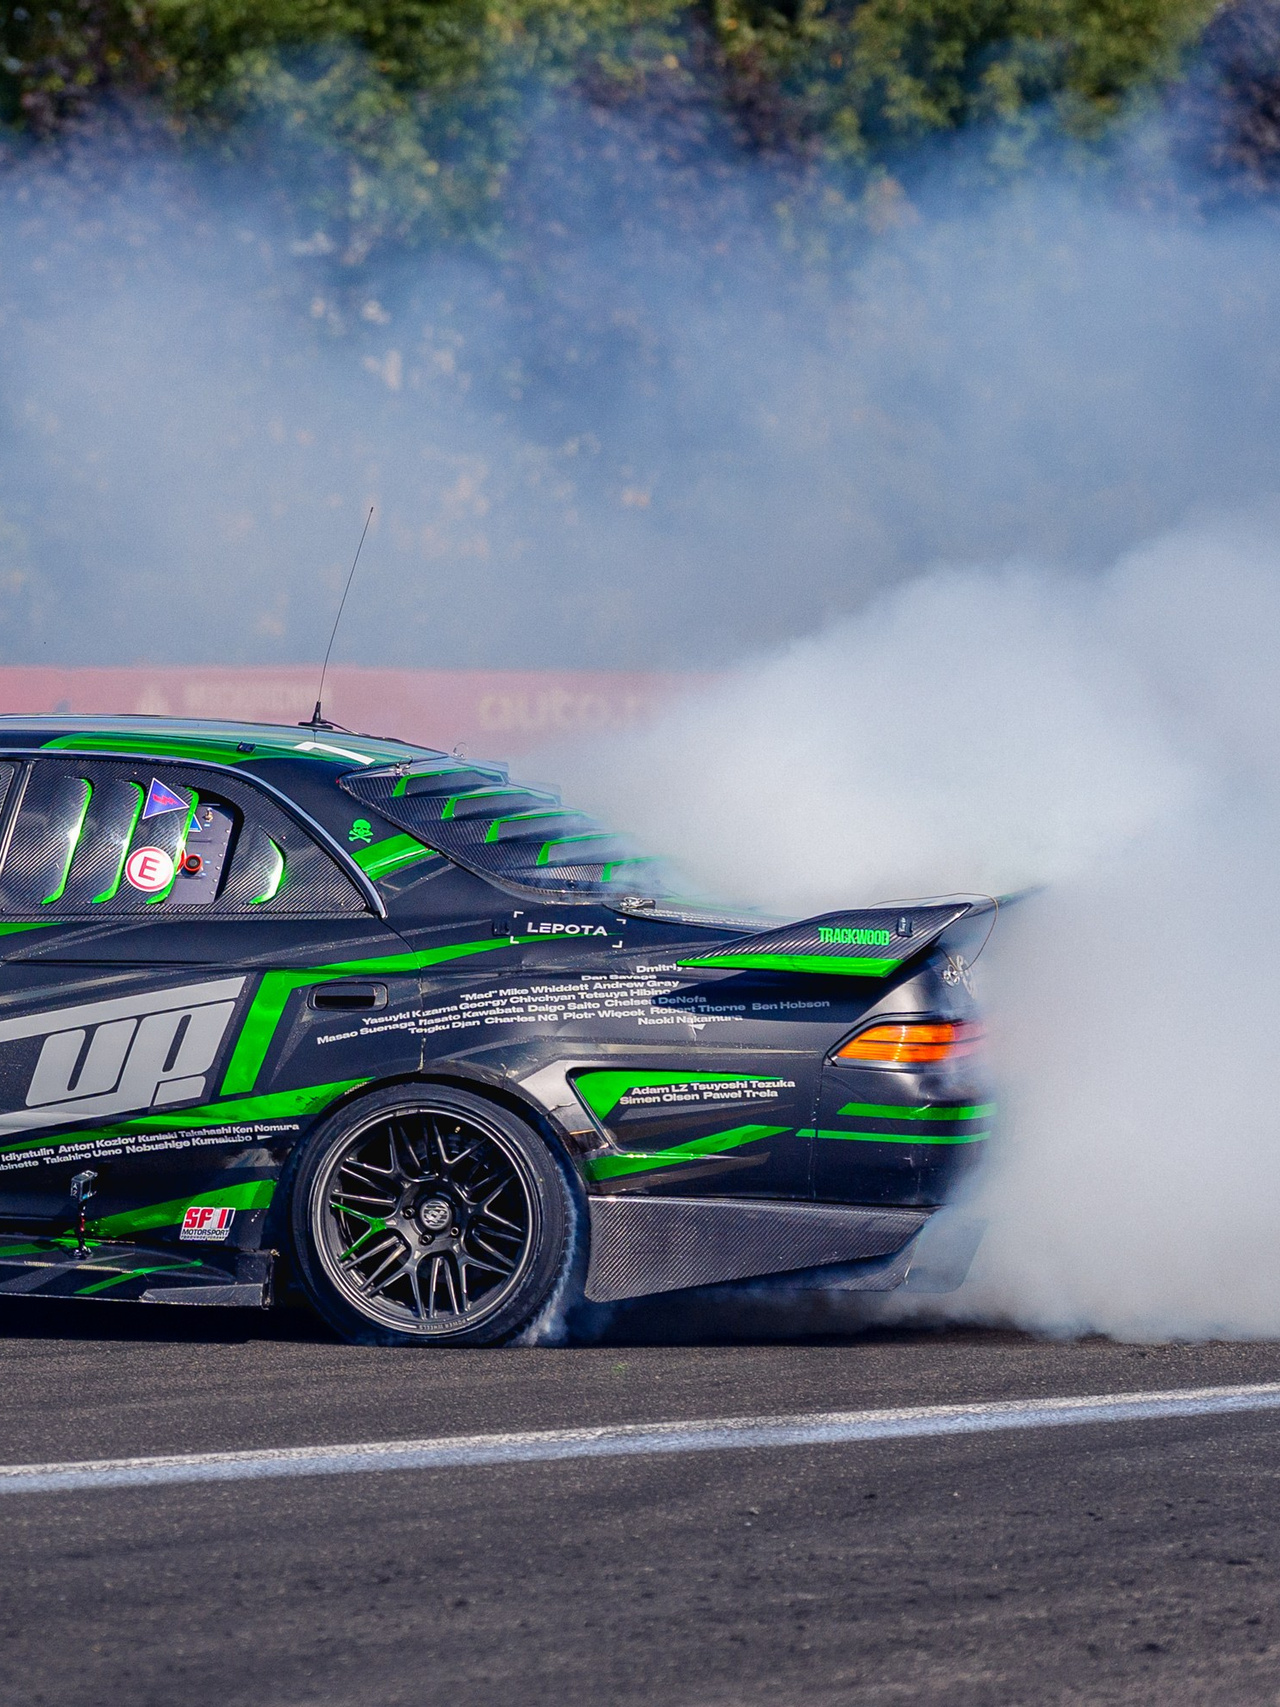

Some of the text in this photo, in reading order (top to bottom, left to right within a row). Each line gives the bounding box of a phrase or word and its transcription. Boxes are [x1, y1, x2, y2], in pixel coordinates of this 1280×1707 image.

[138, 856, 160, 881] E
[527, 922, 608, 936] LEPOTA
[818, 927, 890, 946] TRACKWOOD
[609, 974, 658, 982] Savage
[459, 980, 680, 1002] "Mad" Mike Whiddett Andrew Gray
[459, 997, 508, 1011] Georgy
[509, 993, 576, 1004] Chivchyan
[578, 990, 628, 1000] Tetsuya
[630, 988, 671, 997] Hibino
[317, 1029, 358, 1045] Masao
[360, 1020, 415, 1036] Suenaga
[463, 1005, 524, 1019] Kawabata
[527, 1003, 566, 1015] Daigo
[567, 1001, 601, 1011] Saito
[604, 998, 656, 1008] Chelsea
[658, 995, 707, 1005] DeNofa
[451, 1018, 481, 1030] Djan
[484, 1013, 536, 1025] Charles
[538, 1013, 558, 1022] NG
[563, 1010, 596, 1020] Piotr
[650, 1006, 697, 1015] Robert
[698, 1004, 746, 1013] Thorne
[752, 1002, 778, 1011] Ben
[780, 999, 831, 1010] Hobson
[638, 1013, 743, 1026] Naoki Nakamura
[619, 1094, 660, 1105] Simen
[662, 1092, 700, 1102] Olsen
[744, 1089, 778, 1098] Trela
[632, 1079, 796, 1095] Adam LZ Tsuyoshi Tezuka
[58, 1141, 95, 1154] Anton
[96, 1136, 137, 1149] Kozlov
[138, 1131, 178, 1144] Kuniaki
[178, 1125, 231, 1139] Takahashi
[232, 1124, 253, 1135] Ken
[254, 1122, 300, 1134] Nomura
[43, 1152, 92, 1166] Takahiro
[93, 1147, 122, 1159] Ueno
[126, 1140, 190, 1155] Nobushige
[192, 1134, 252, 1147] Kumakubo
[181, 1228, 230, 1236] MOTORSPORT
